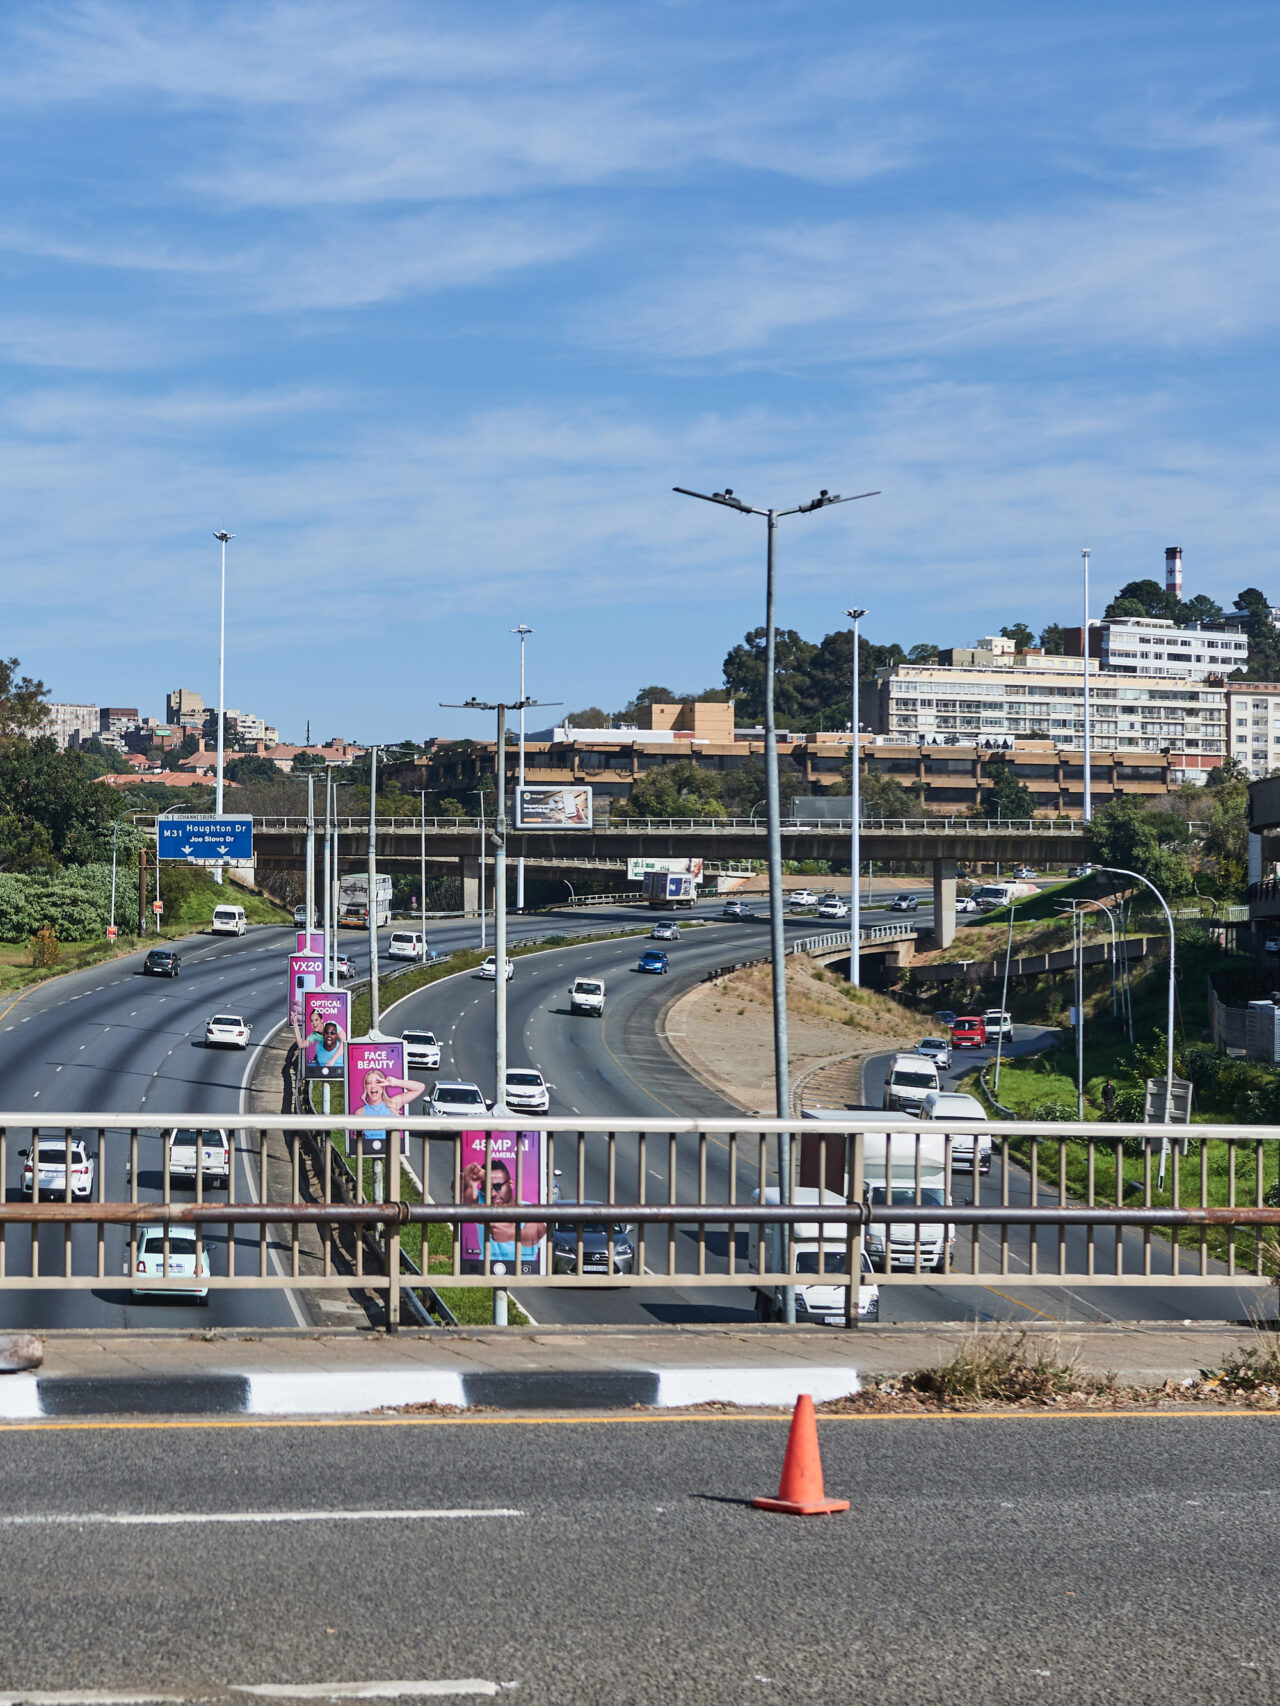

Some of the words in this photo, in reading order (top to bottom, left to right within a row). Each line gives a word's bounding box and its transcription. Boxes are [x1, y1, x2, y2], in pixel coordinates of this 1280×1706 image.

[186, 824, 231, 834] Houghton
[293, 962, 322, 971] VX20
[364, 1051, 387, 1059] FACE
[358, 1061, 394, 1069] BEAUTY
